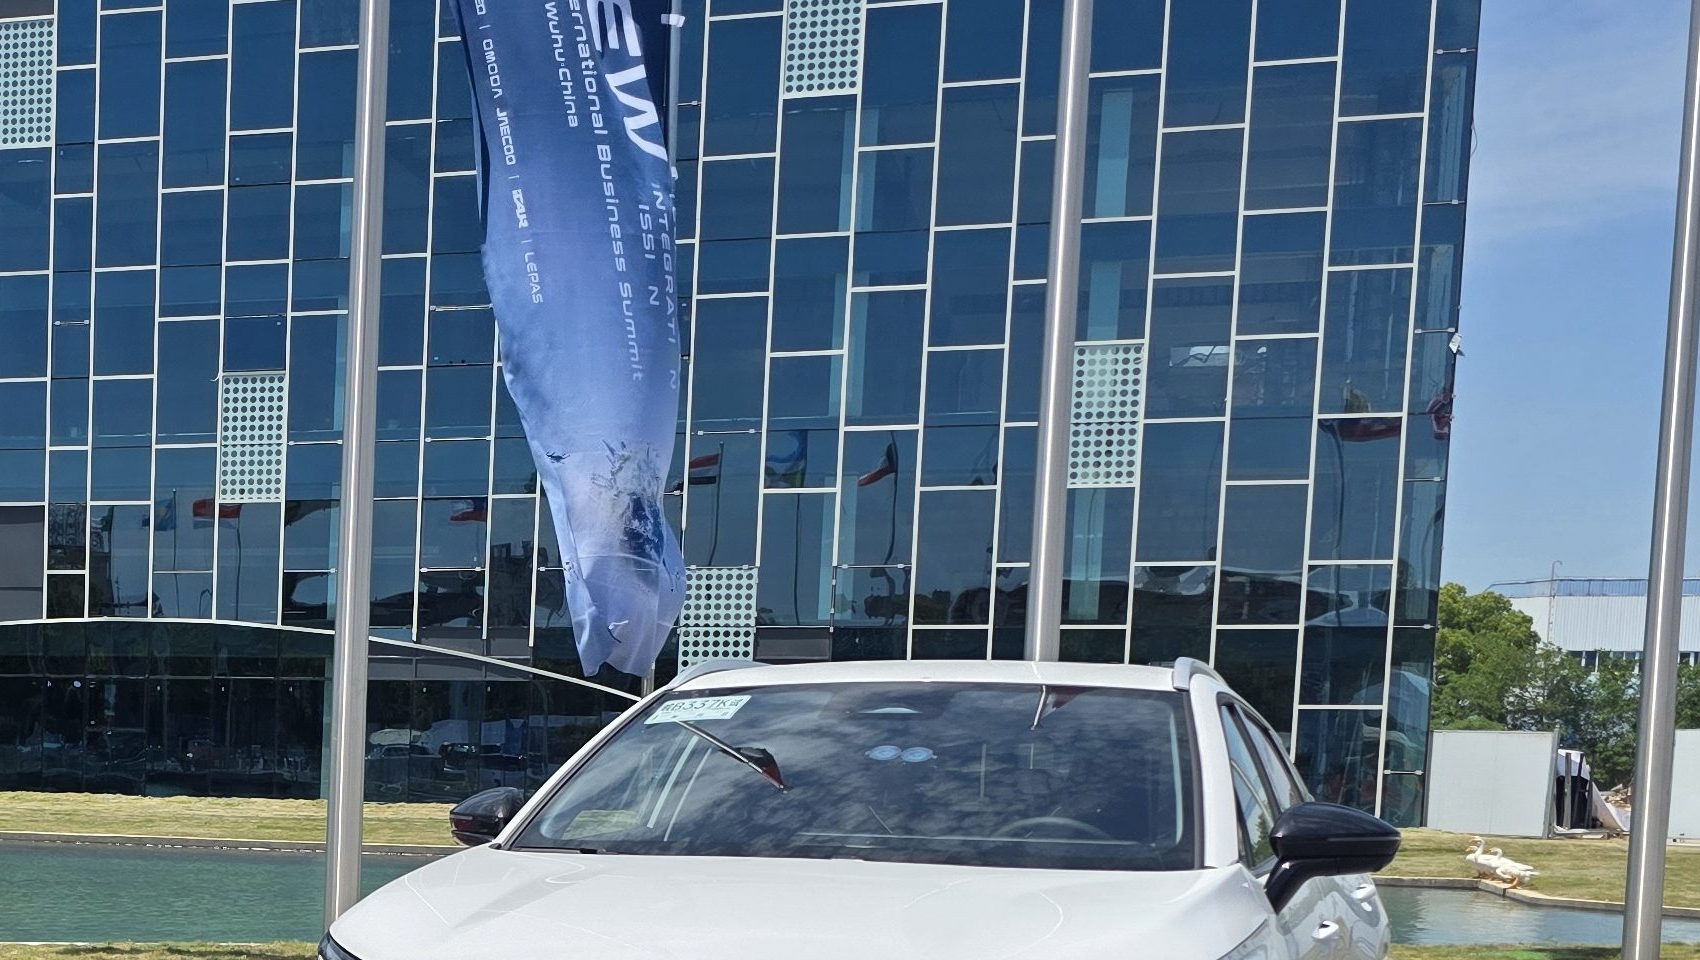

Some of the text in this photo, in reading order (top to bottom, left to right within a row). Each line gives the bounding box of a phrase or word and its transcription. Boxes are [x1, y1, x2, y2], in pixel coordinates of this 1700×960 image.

[482, 38, 503, 99] OMODA
[496, 107, 517, 166] JAECOO
[524, 251, 544, 304] LEPAS
[597, 144, 626, 273] Business
[619, 281, 644, 381] Summit
